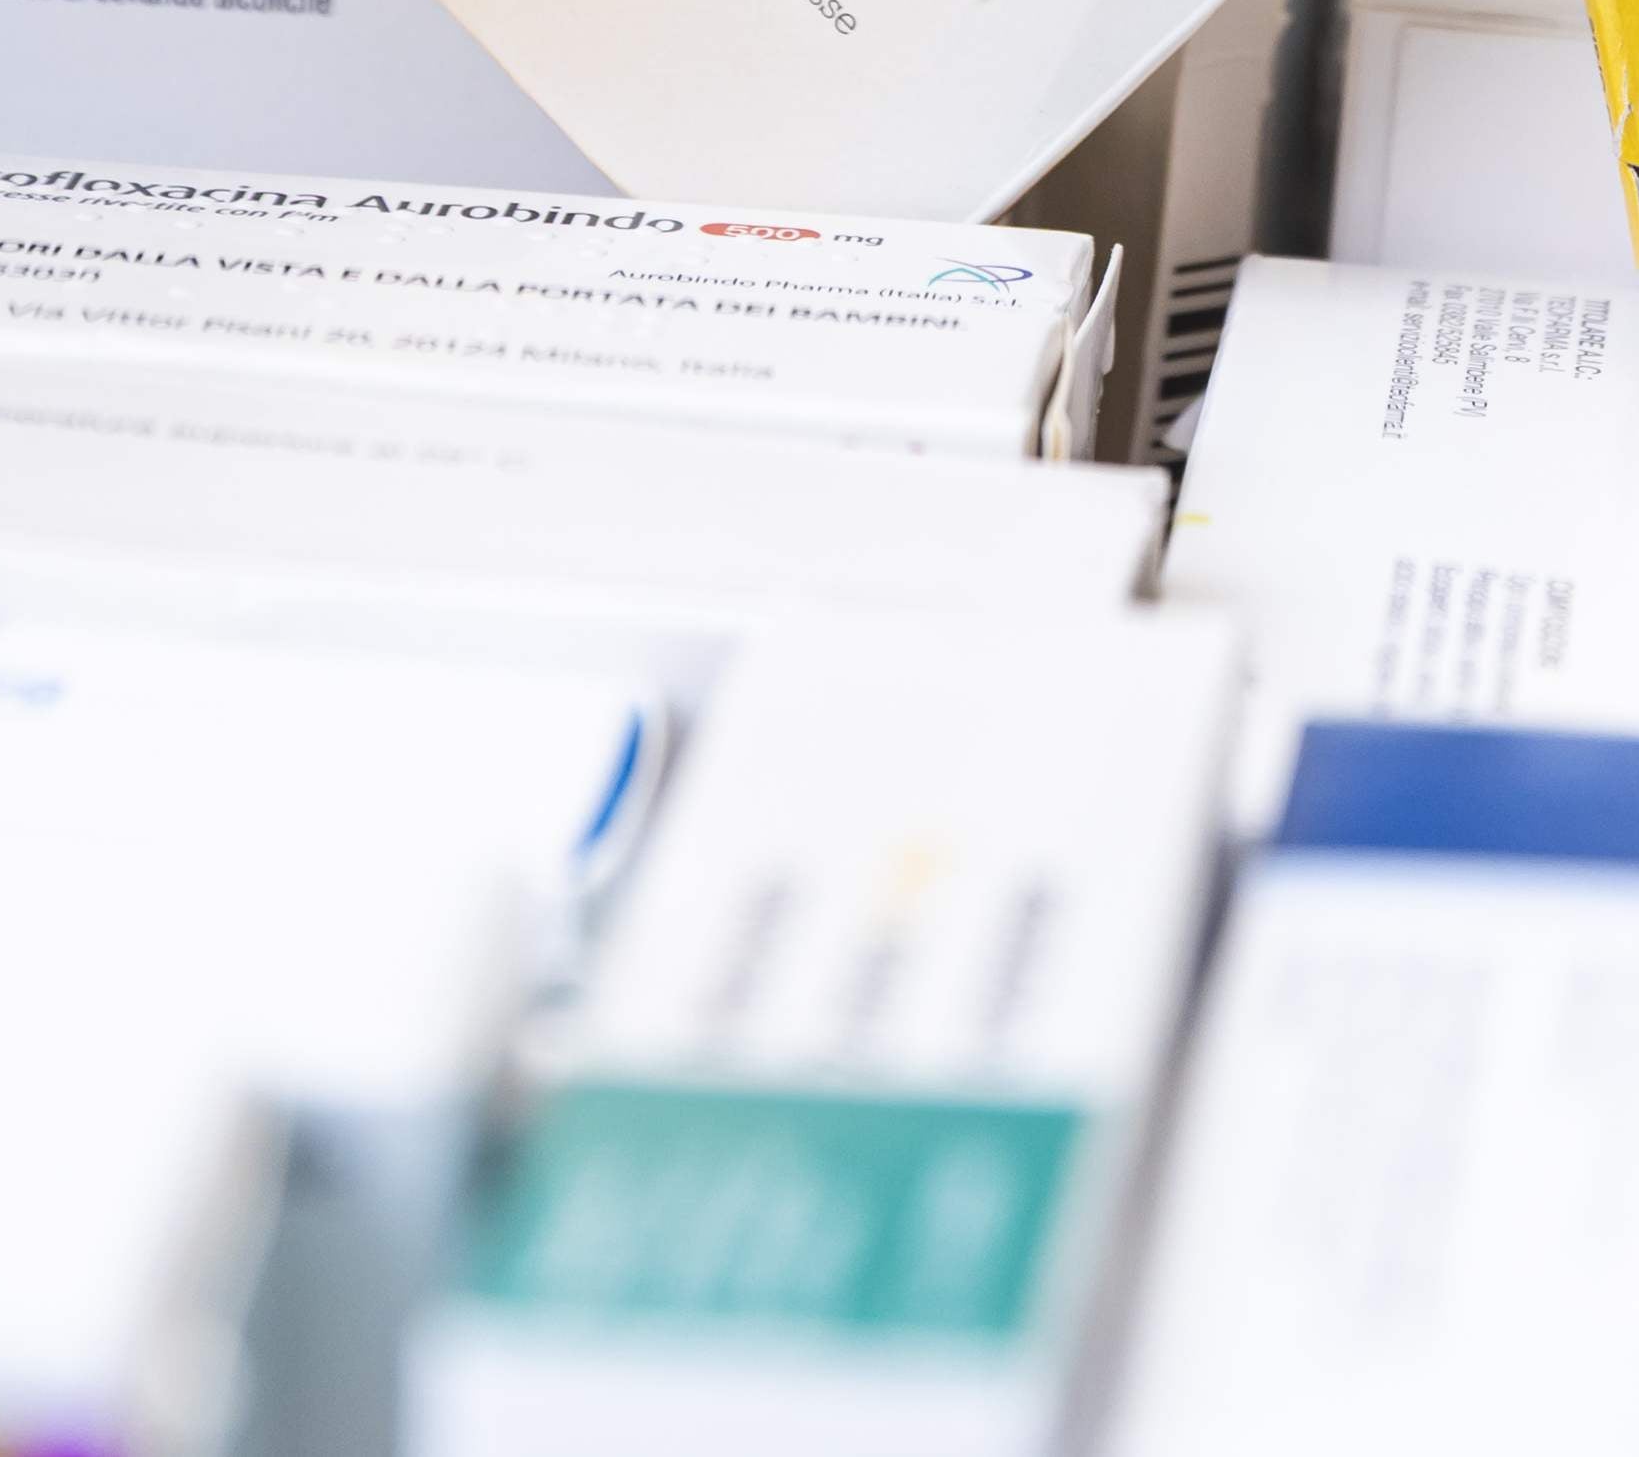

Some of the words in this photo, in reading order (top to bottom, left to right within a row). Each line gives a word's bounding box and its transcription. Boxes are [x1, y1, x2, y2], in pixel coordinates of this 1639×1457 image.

[215, 203, 265, 220] con
[350, 193, 685, 234] Aurobindo
[725, 223, 801, 243] 500
[833, 231, 885, 248] mg
[76, 245, 200, 269] DALLA
[218, 257, 326, 281] VISTA
[341, 268, 360, 282] E
[375, 272, 502, 295] DALLA
[517, 283, 698, 312] PORTATA
[716, 299, 776, 319] DEI
[609, 268, 757, 290] Aurobindo
[764, 279, 870, 298] Pharma
[878, 287, 962, 304] (Italia)
[971, 293, 1023, 309] S.r.l.
[1575, 298, 1612, 348] TITOLARE
[1503, 355, 1530, 363] 8
